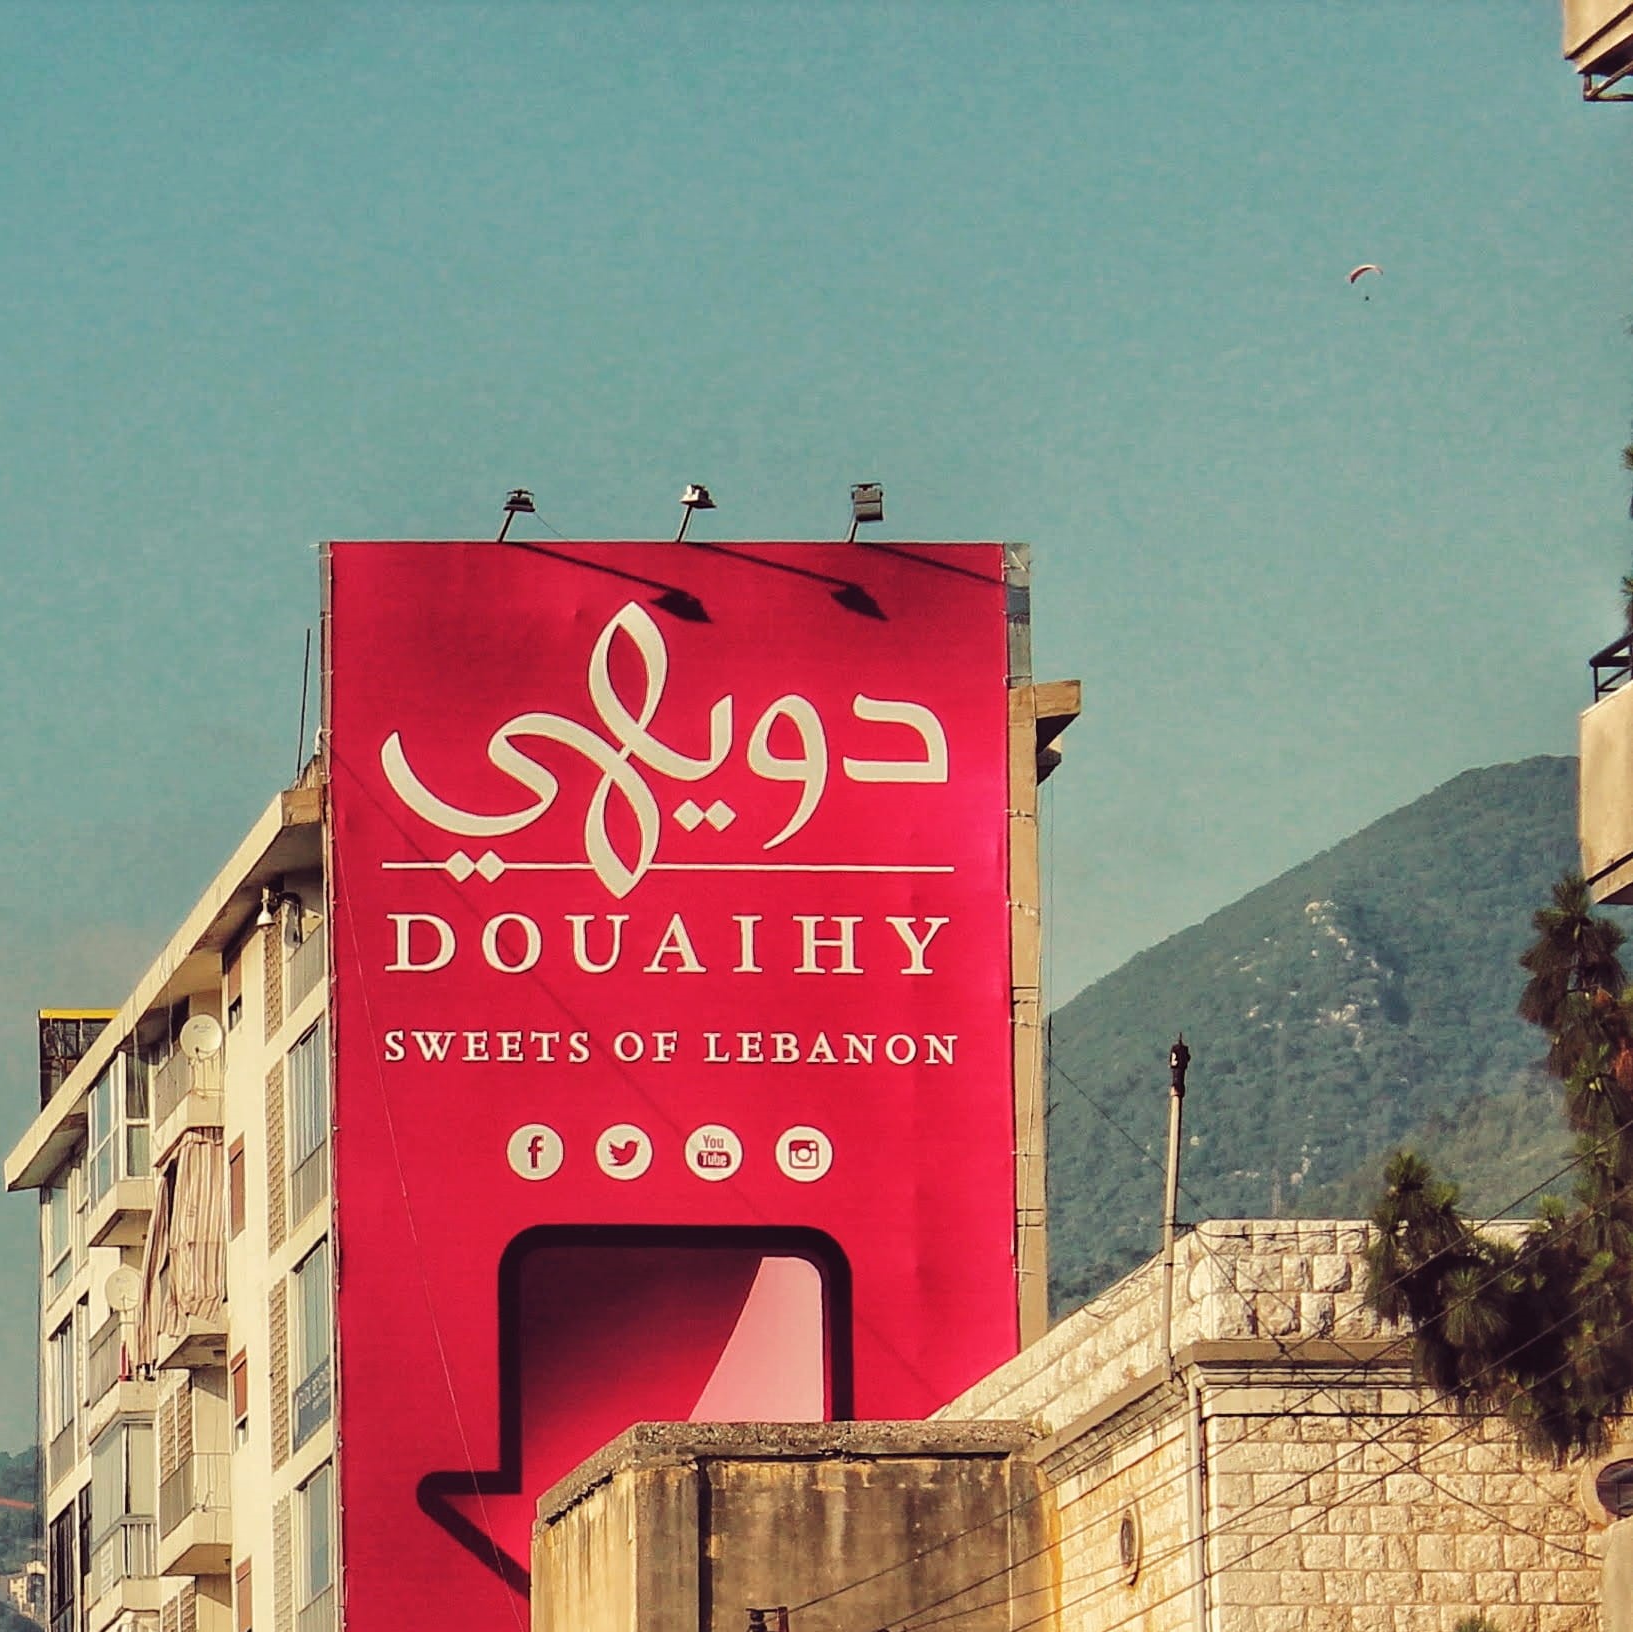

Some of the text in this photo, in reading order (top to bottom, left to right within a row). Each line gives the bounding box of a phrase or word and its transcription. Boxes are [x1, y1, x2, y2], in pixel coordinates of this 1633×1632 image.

[380, 600, 948, 899] دويهي
[385, 911, 951, 976] DOUAIHY
[384, 1029, 959, 1066] SWEETS OF LEBANON
[702, 1134, 725, 1149] You
